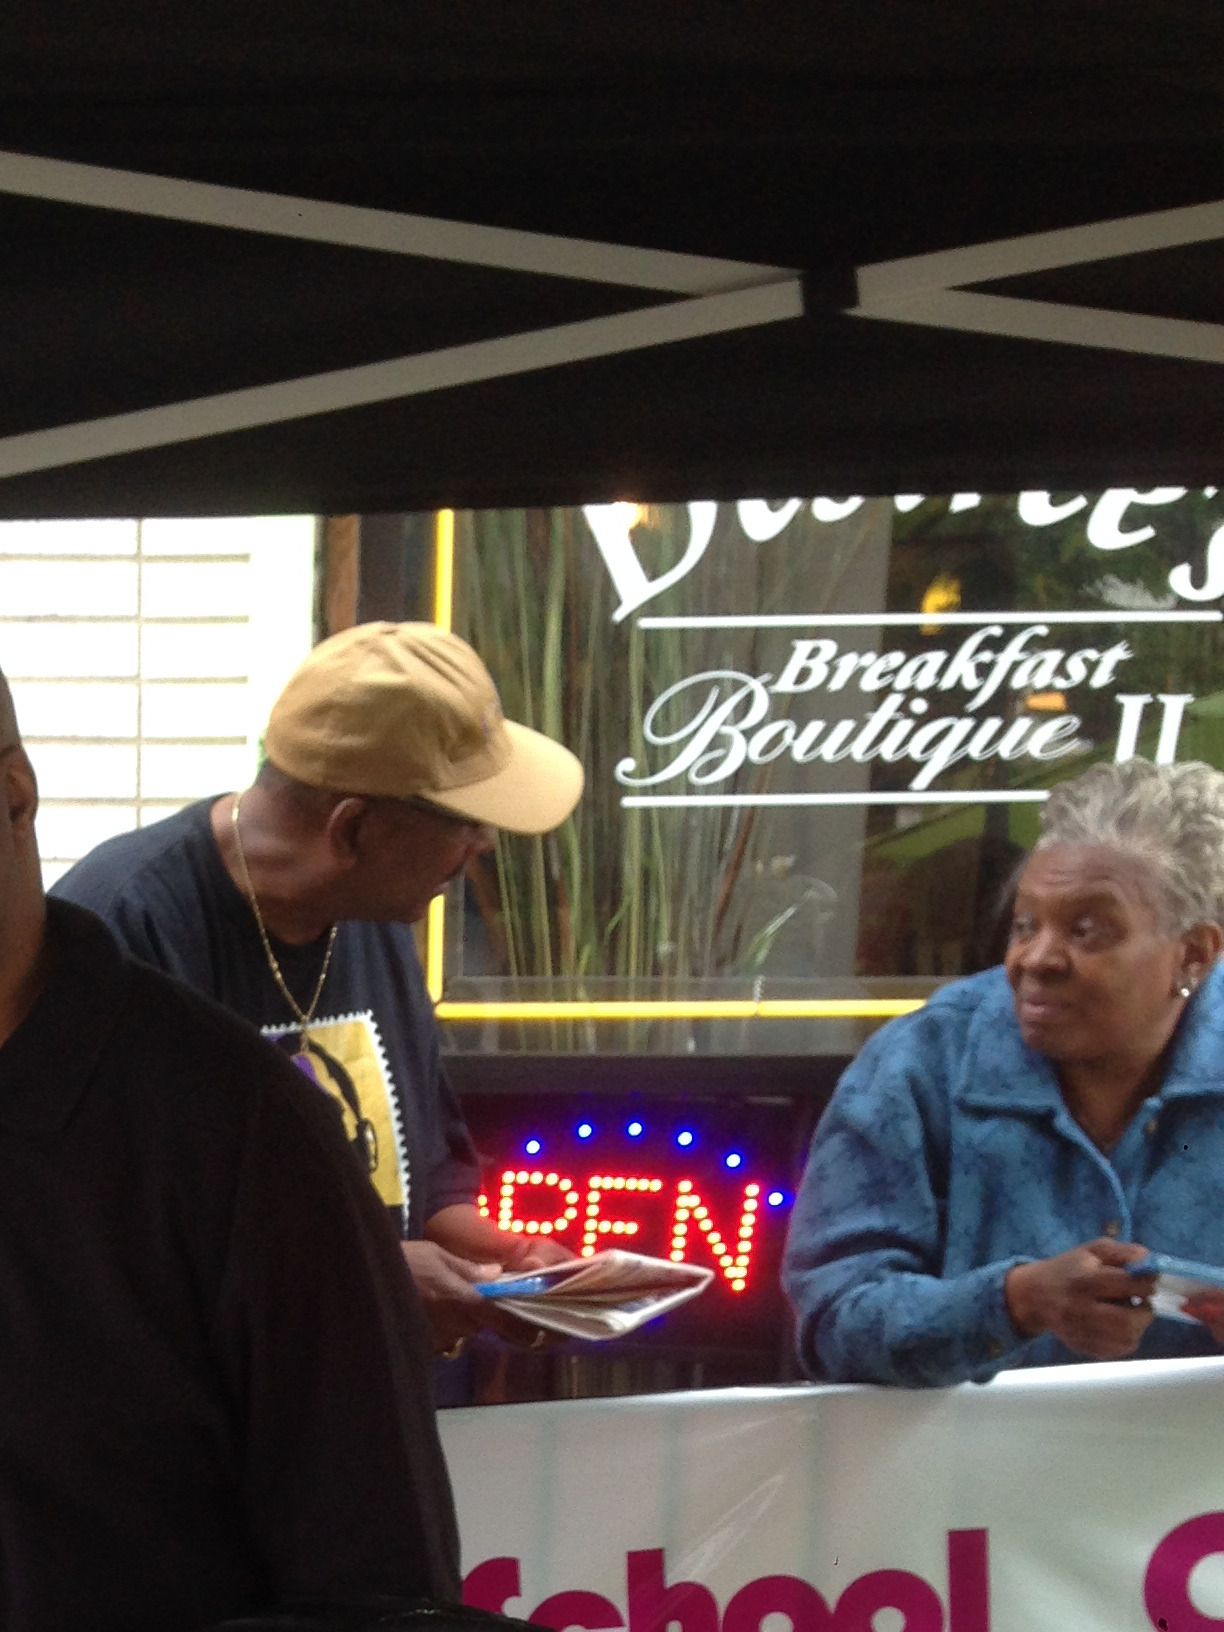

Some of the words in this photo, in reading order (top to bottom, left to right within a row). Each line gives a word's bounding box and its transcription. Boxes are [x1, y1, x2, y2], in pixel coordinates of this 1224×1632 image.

[769, 625, 1134, 712] Breakfast
[614, 669, 1081, 790] Boutique
[1116, 693, 1195, 765] II
[477, 1170, 761, 1292] PEN
